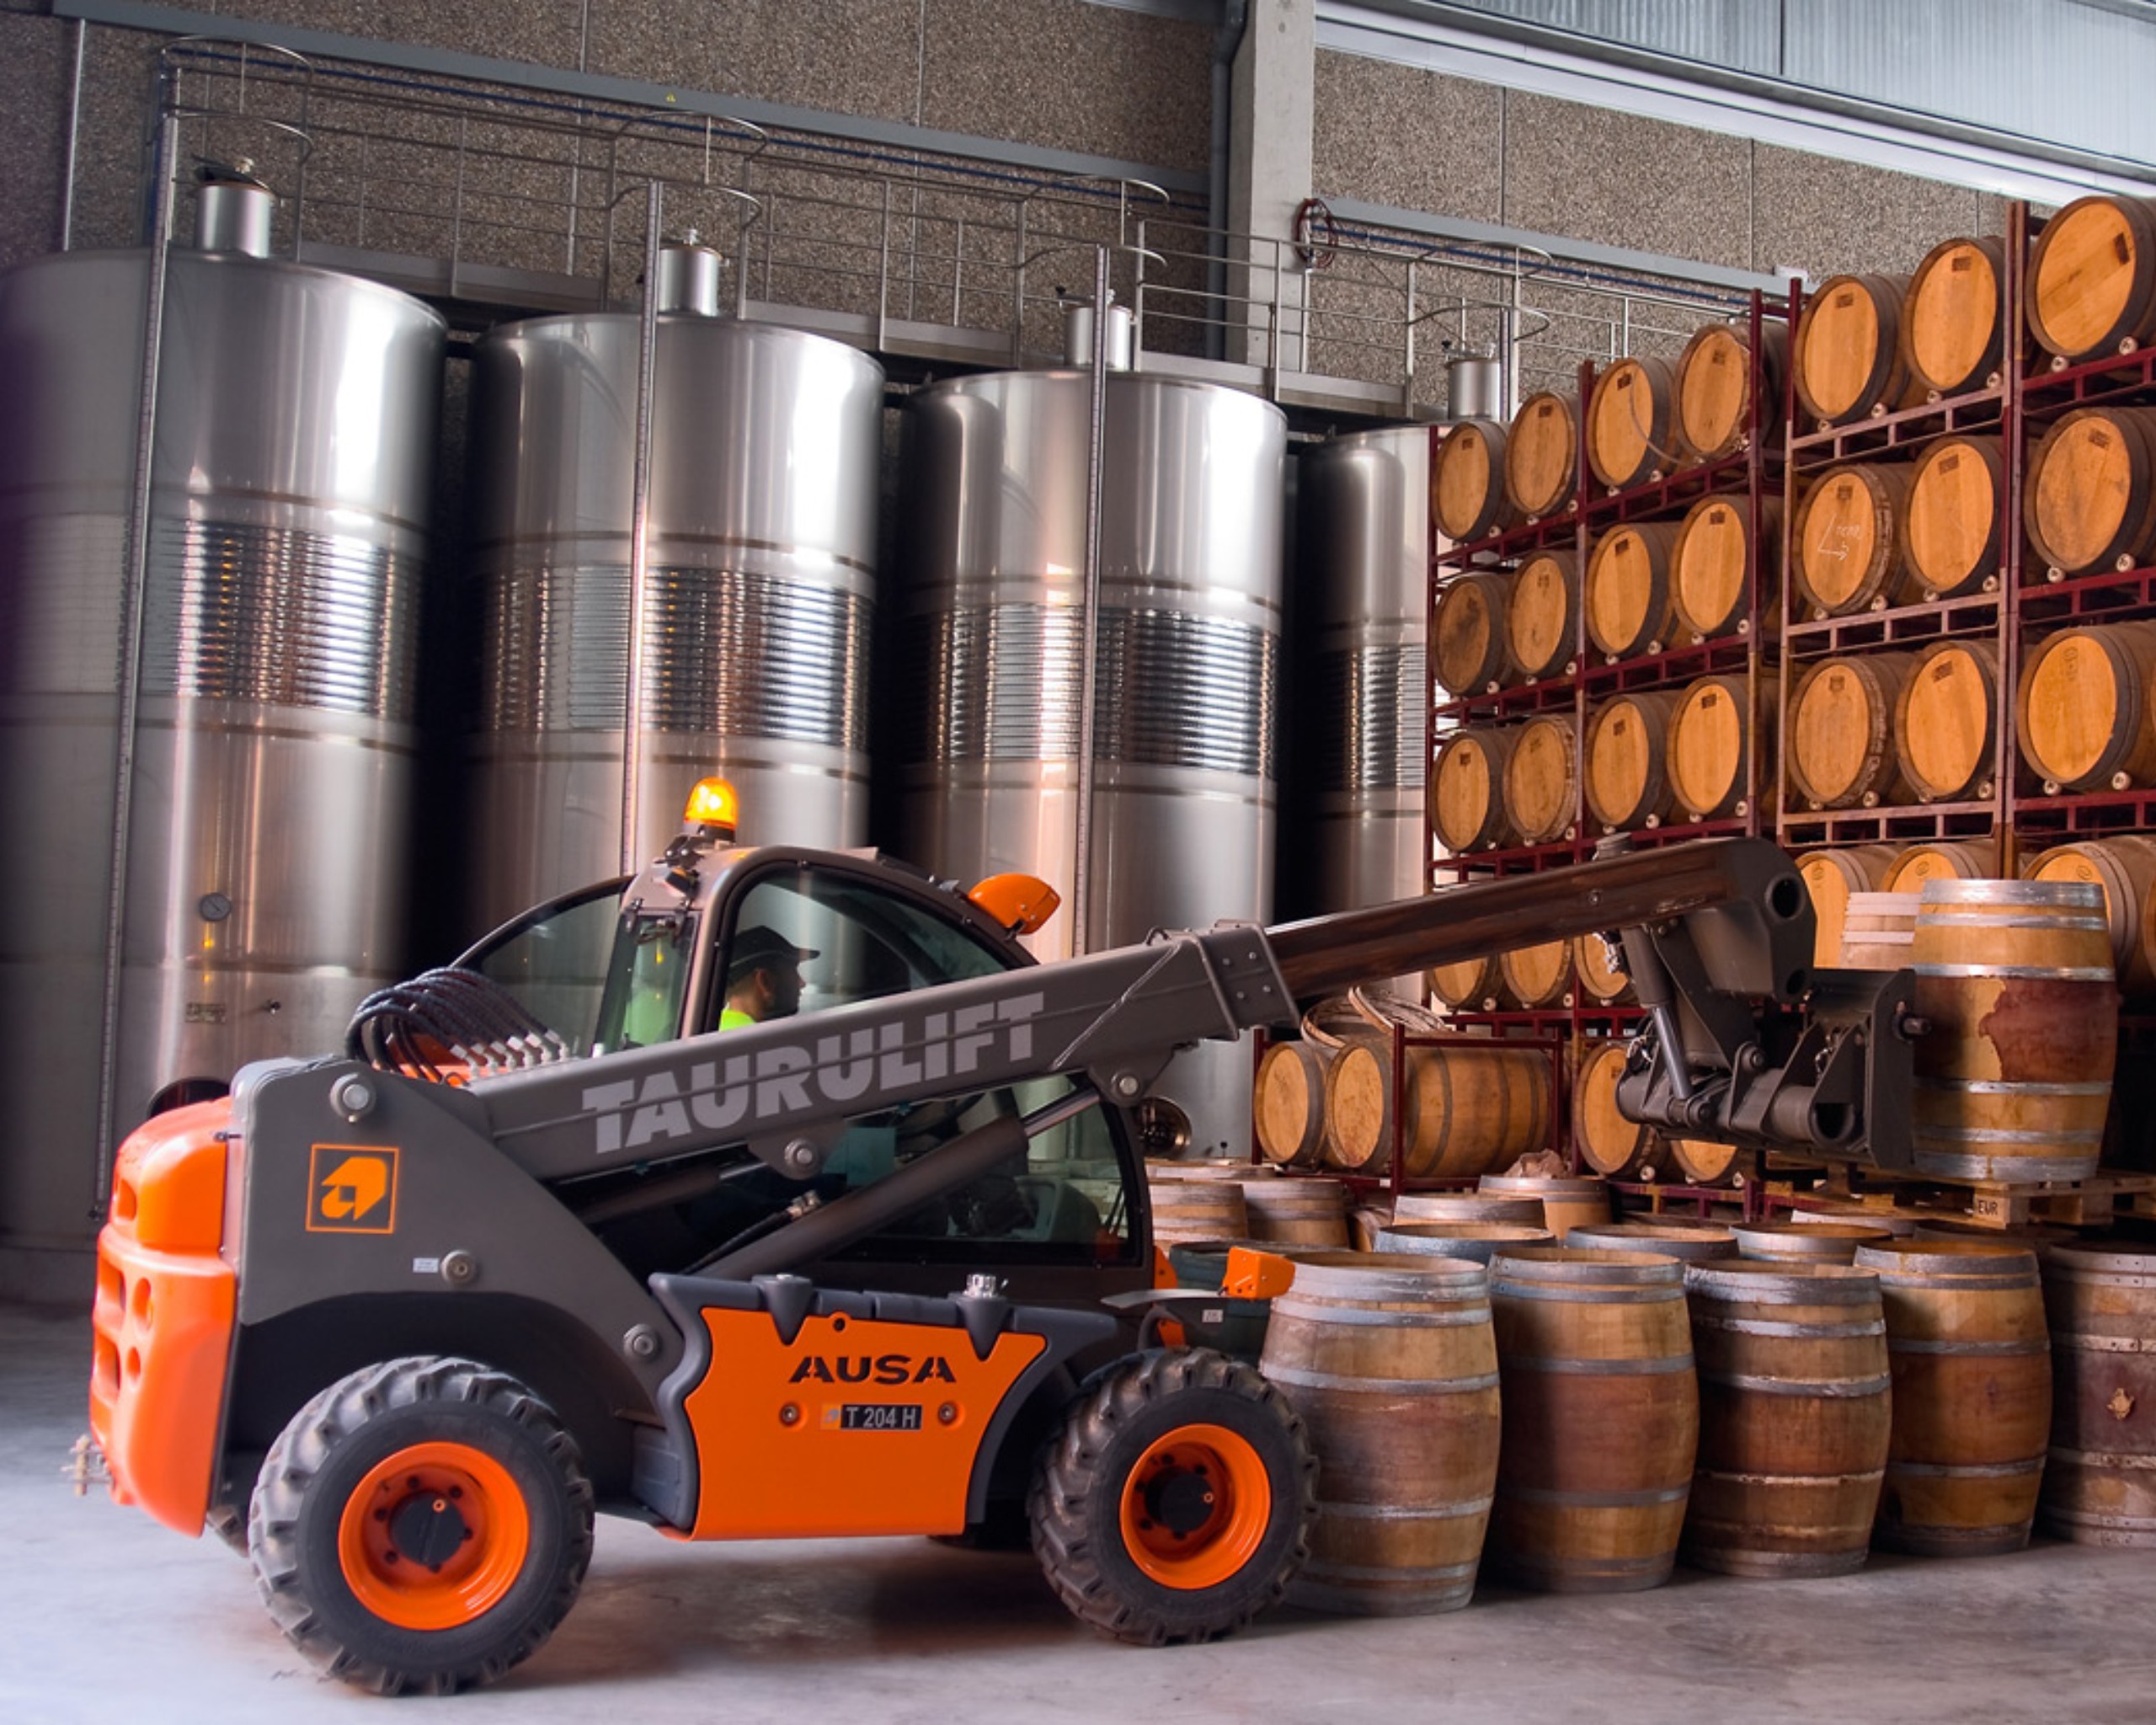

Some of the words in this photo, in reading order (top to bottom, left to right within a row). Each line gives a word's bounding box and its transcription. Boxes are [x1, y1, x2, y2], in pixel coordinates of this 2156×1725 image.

[582, 991, 1044, 1155] TAURULIFT
[1977, 1199, 1999, 1215] EUR
[788, 1354, 957, 1385] AUSA
[846, 1406, 859, 1428] T
[862, 1406, 897, 1429] 204
[902, 1407, 917, 1429] H
